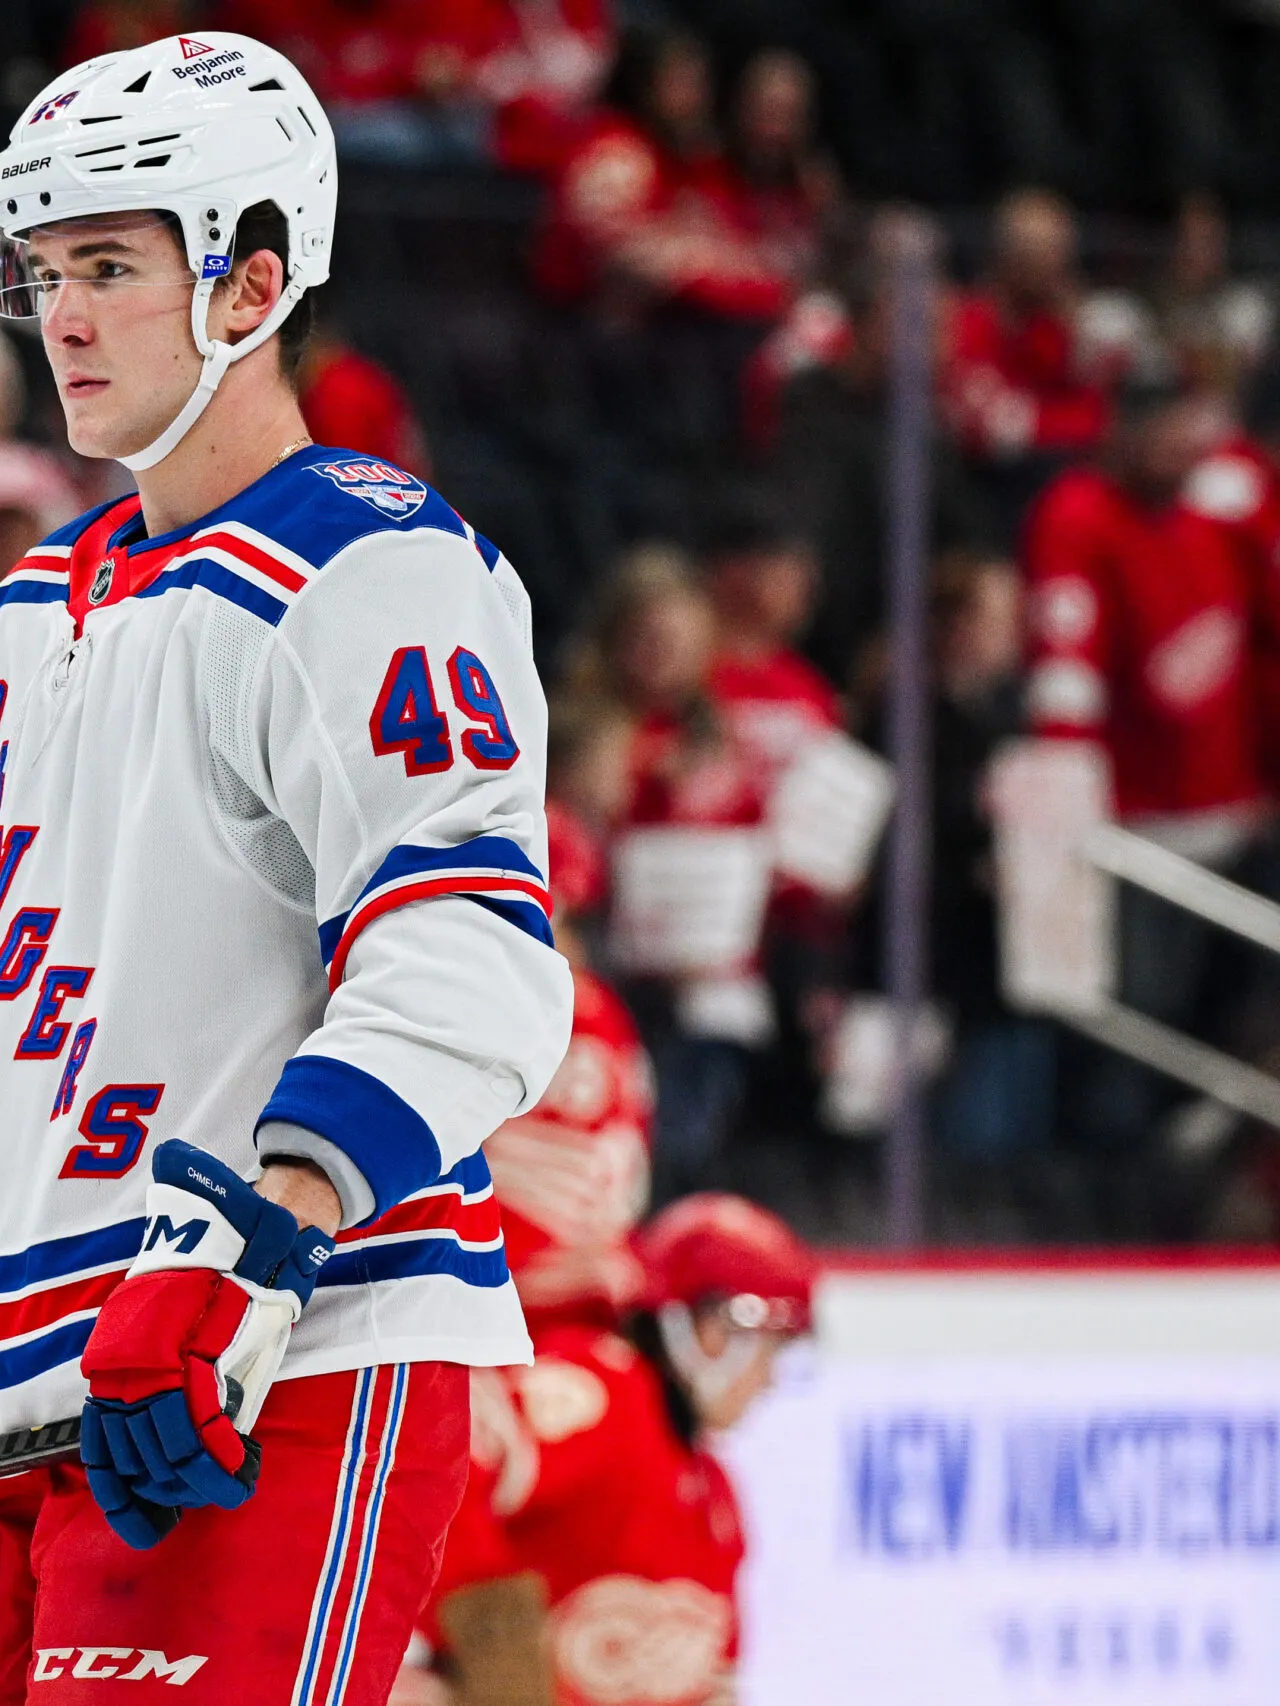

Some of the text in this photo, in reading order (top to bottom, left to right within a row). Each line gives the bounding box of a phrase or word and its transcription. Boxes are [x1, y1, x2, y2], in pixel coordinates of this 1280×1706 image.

[172, 50, 244, 79] Benjamin
[194, 66, 246, 89] Moore
[1, 157, 51, 179] BAUER
[323, 463, 412, 485] 100
[369, 645, 520, 777] 49
[187, 1166, 227, 1198] CHMELAR
[33, 1646, 209, 1686] CCM
